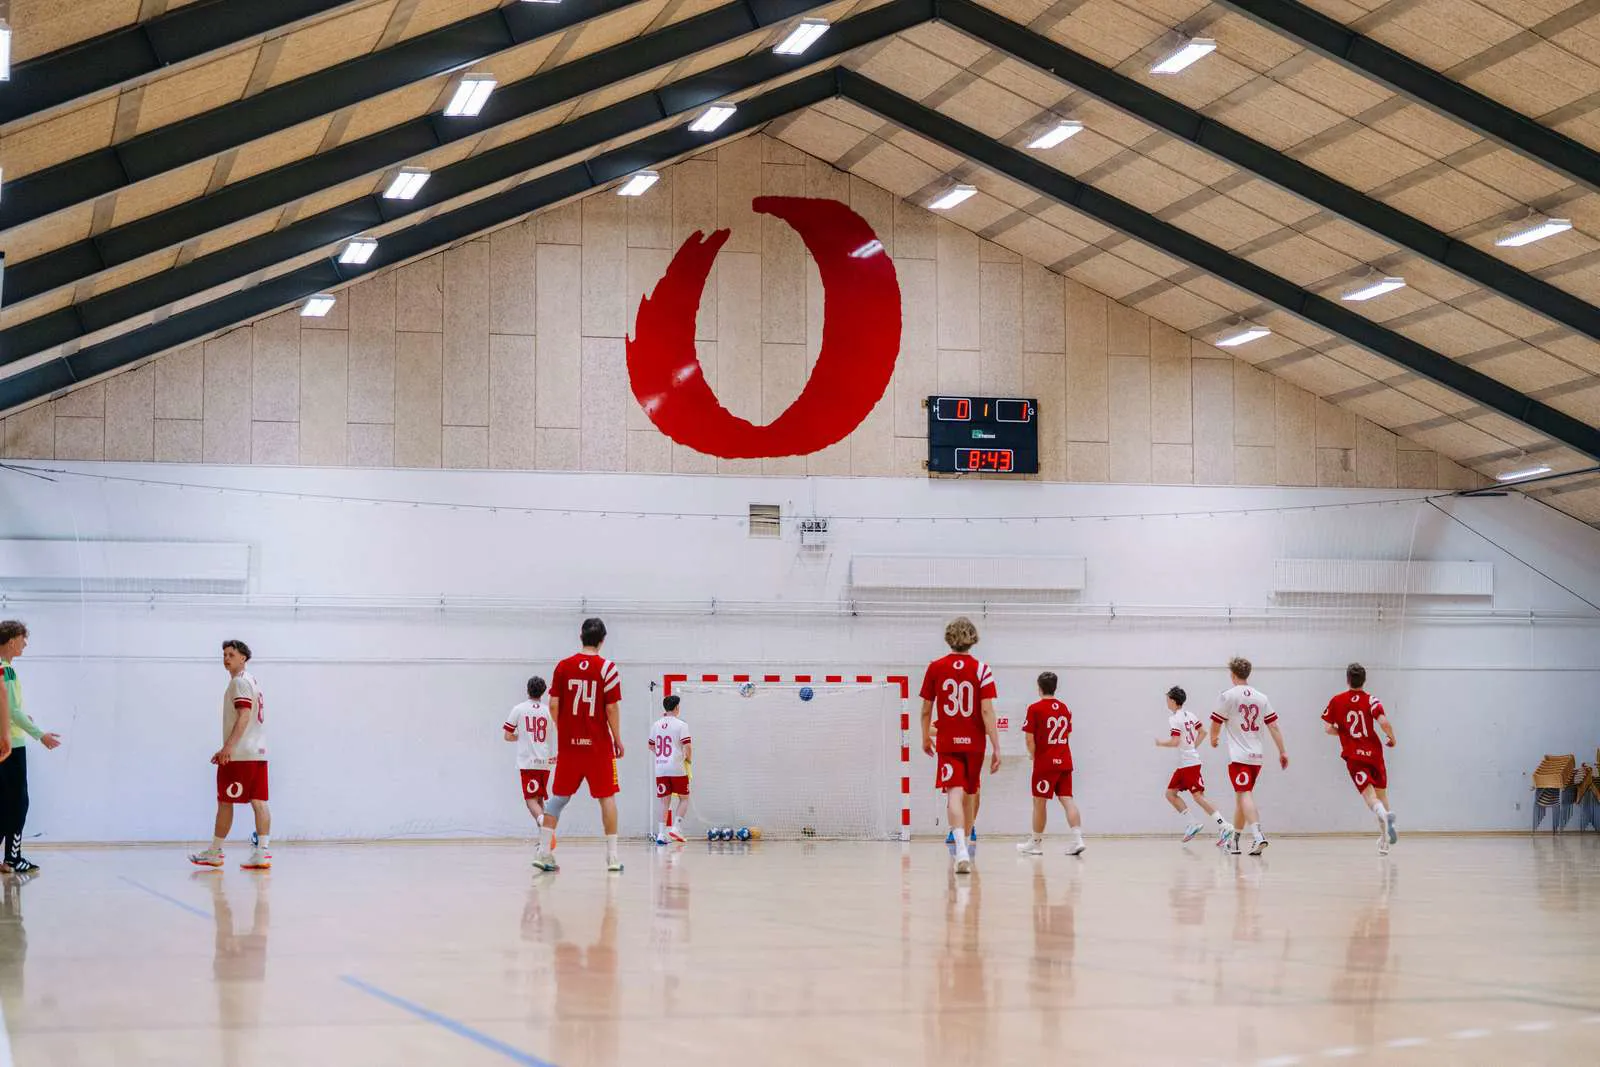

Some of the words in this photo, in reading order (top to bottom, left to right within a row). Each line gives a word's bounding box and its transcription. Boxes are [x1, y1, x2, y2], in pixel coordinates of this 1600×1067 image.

[933, 403, 939, 413] H
[957, 400, 968, 419] 0
[1021, 402, 1028, 419] 1
[1028, 407, 1034, 416] G
[969, 450, 1011, 470] 8:43
[568, 679, 597, 717] 74
[942, 678, 974, 718] 30
[525, 715, 548, 743] 48
[1046, 716, 1069, 745] 22
[1238, 704, 1260, 732] 32
[1346, 710, 1369, 738] 21
[655, 734, 673, 758] 96
